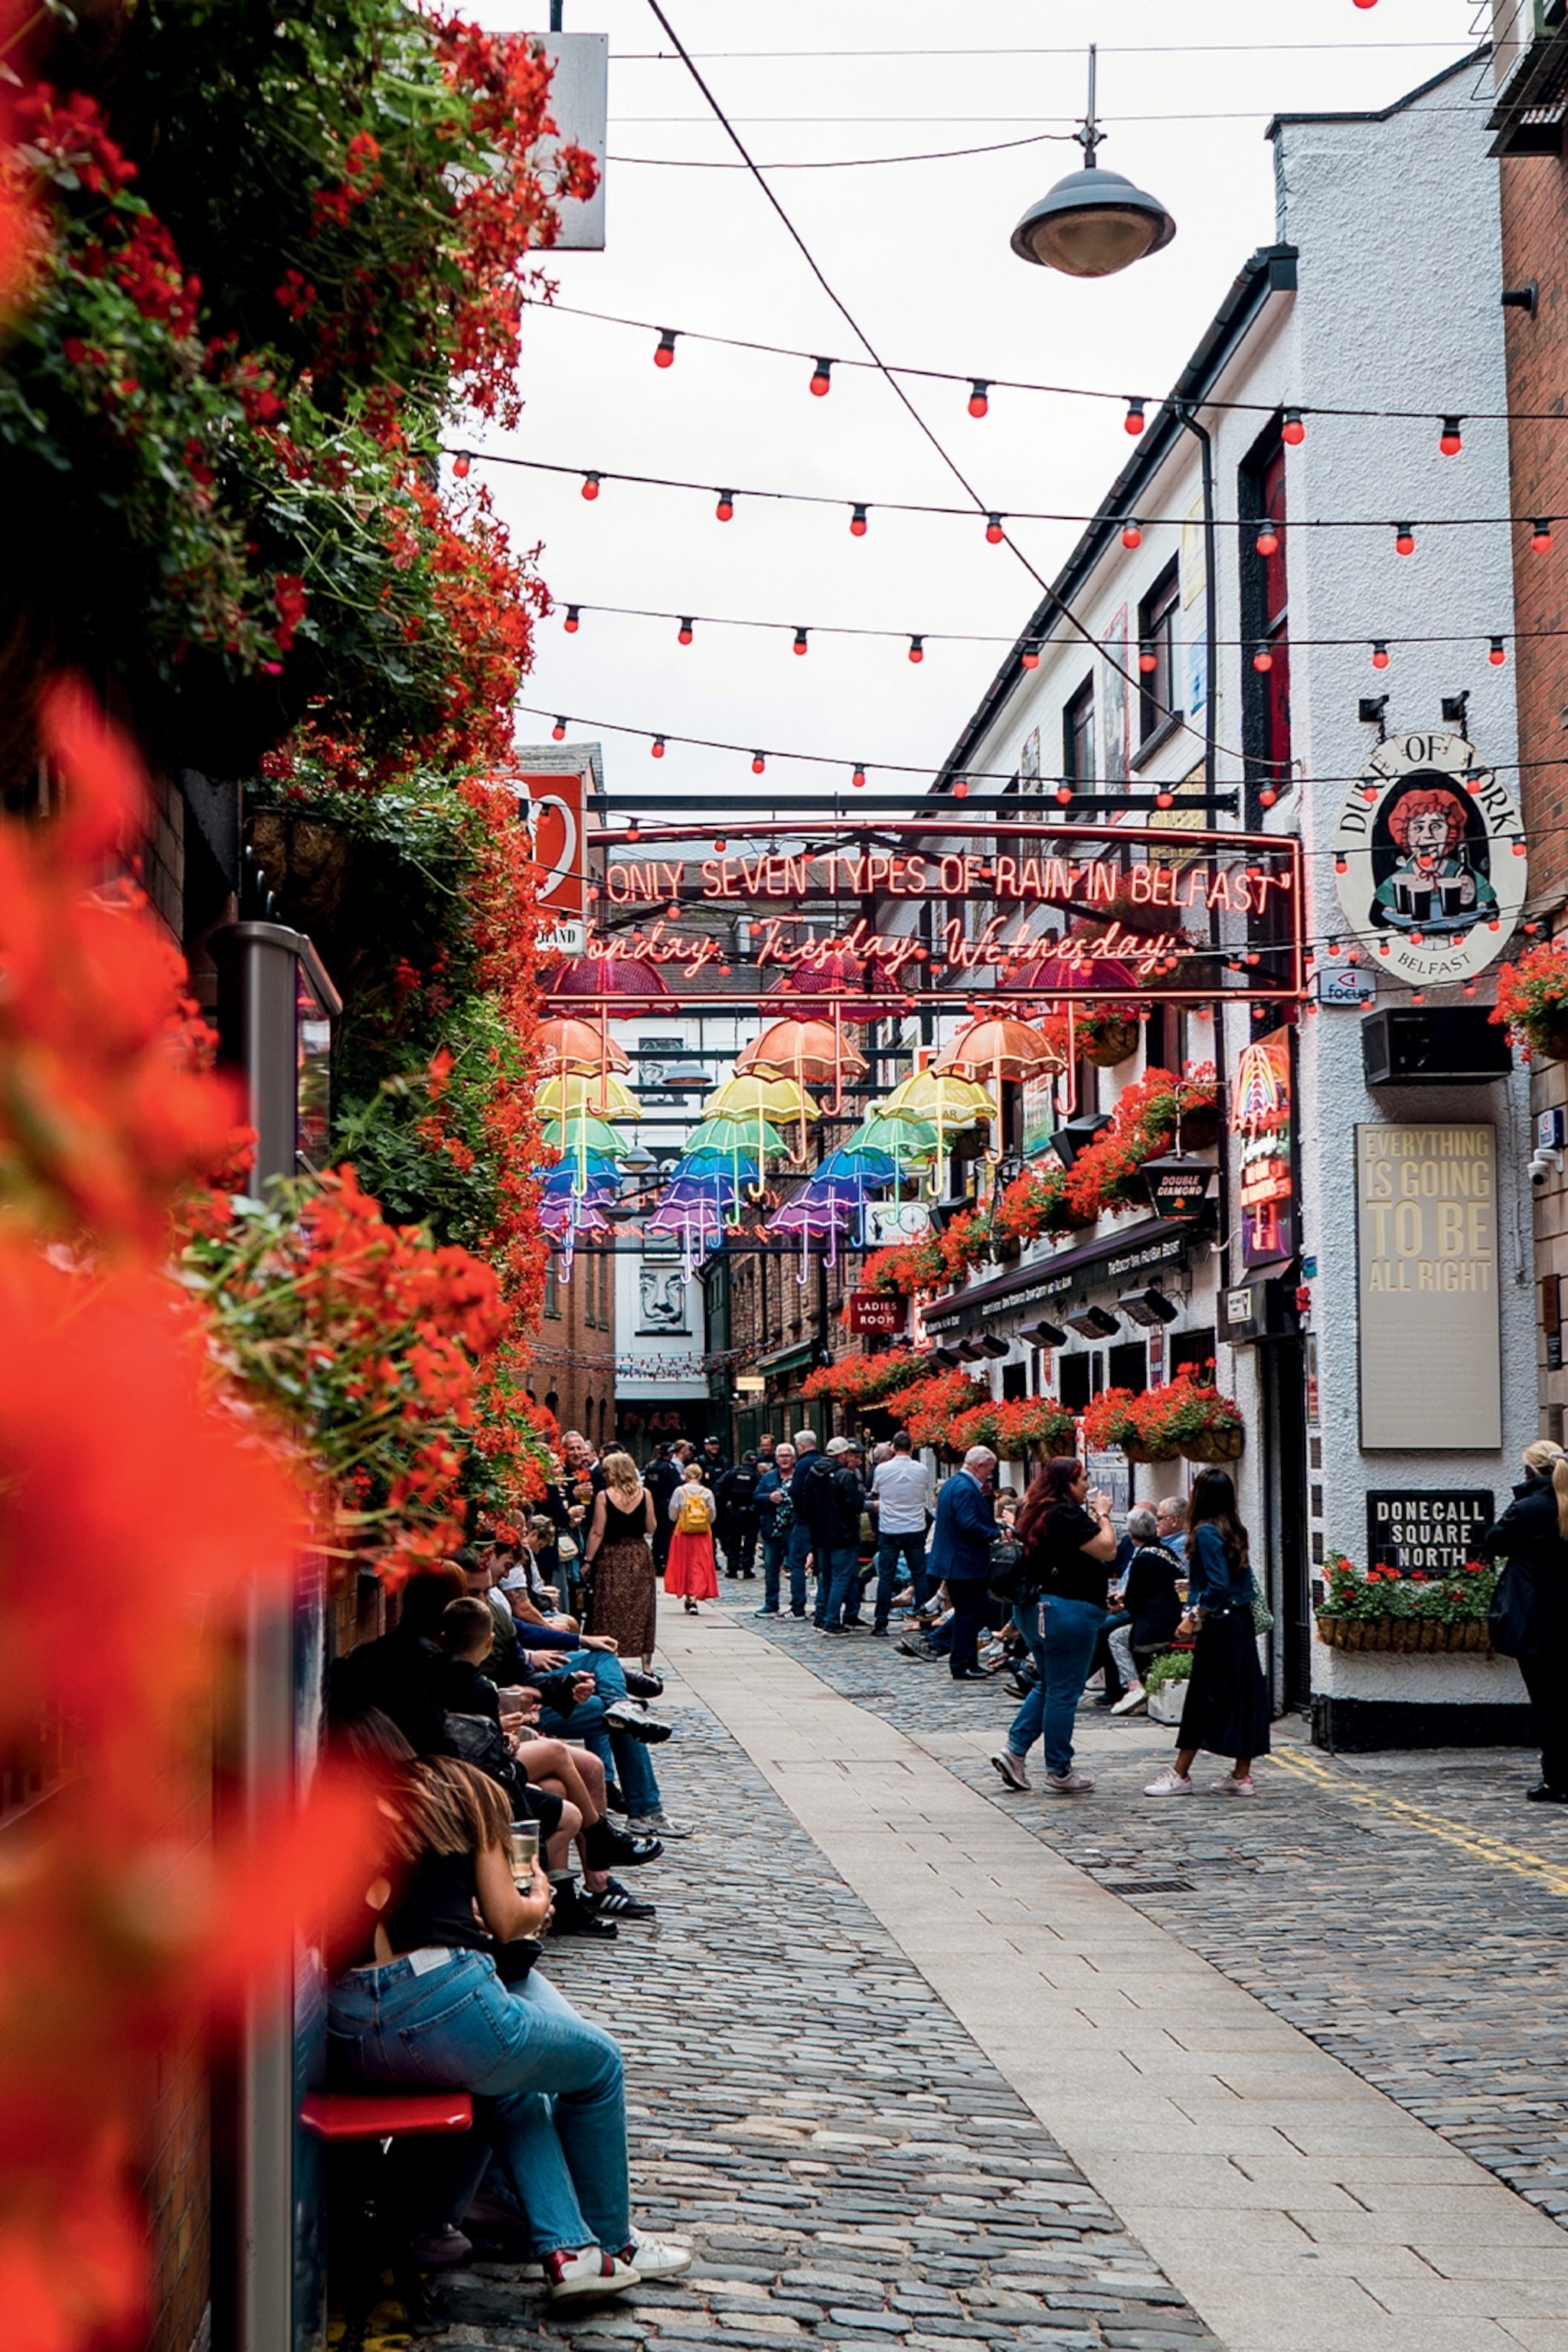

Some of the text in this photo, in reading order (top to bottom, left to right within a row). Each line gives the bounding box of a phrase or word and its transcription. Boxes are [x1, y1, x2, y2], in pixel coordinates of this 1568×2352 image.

[1340, 736, 1519, 835] DUKE OF YORK
[607, 860, 684, 903] ONLY
[701, 856, 806, 897] SEVEN
[824, 855, 926, 894] TYPES
[940, 855, 982, 894] OF
[996, 856, 1073, 900] RAIN
[1086, 861, 1117, 902] IN
[1397, 952, 1472, 975] BELFAST
[1328, 985, 1369, 1000] focus
[1364, 1130, 1490, 1157] EVERYTHING
[1161, 1175, 1200, 1186] DOUBLE
[1365, 1158, 1491, 1197] IS GOING
[1158, 1186, 1203, 1196] DIAMOND
[1366, 1199, 1491, 1257] TO BE
[1368, 1259, 1491, 1292] ALL RIGHT
[858, 1302, 897, 1312] LADIES
[860, 1315, 895, 1325] ROOM
[1377, 1501, 1485, 1521] DONEGALL
[1391, 1524, 1472, 1544] SQUARE
[1397, 1547, 1467, 1566] NORTH
